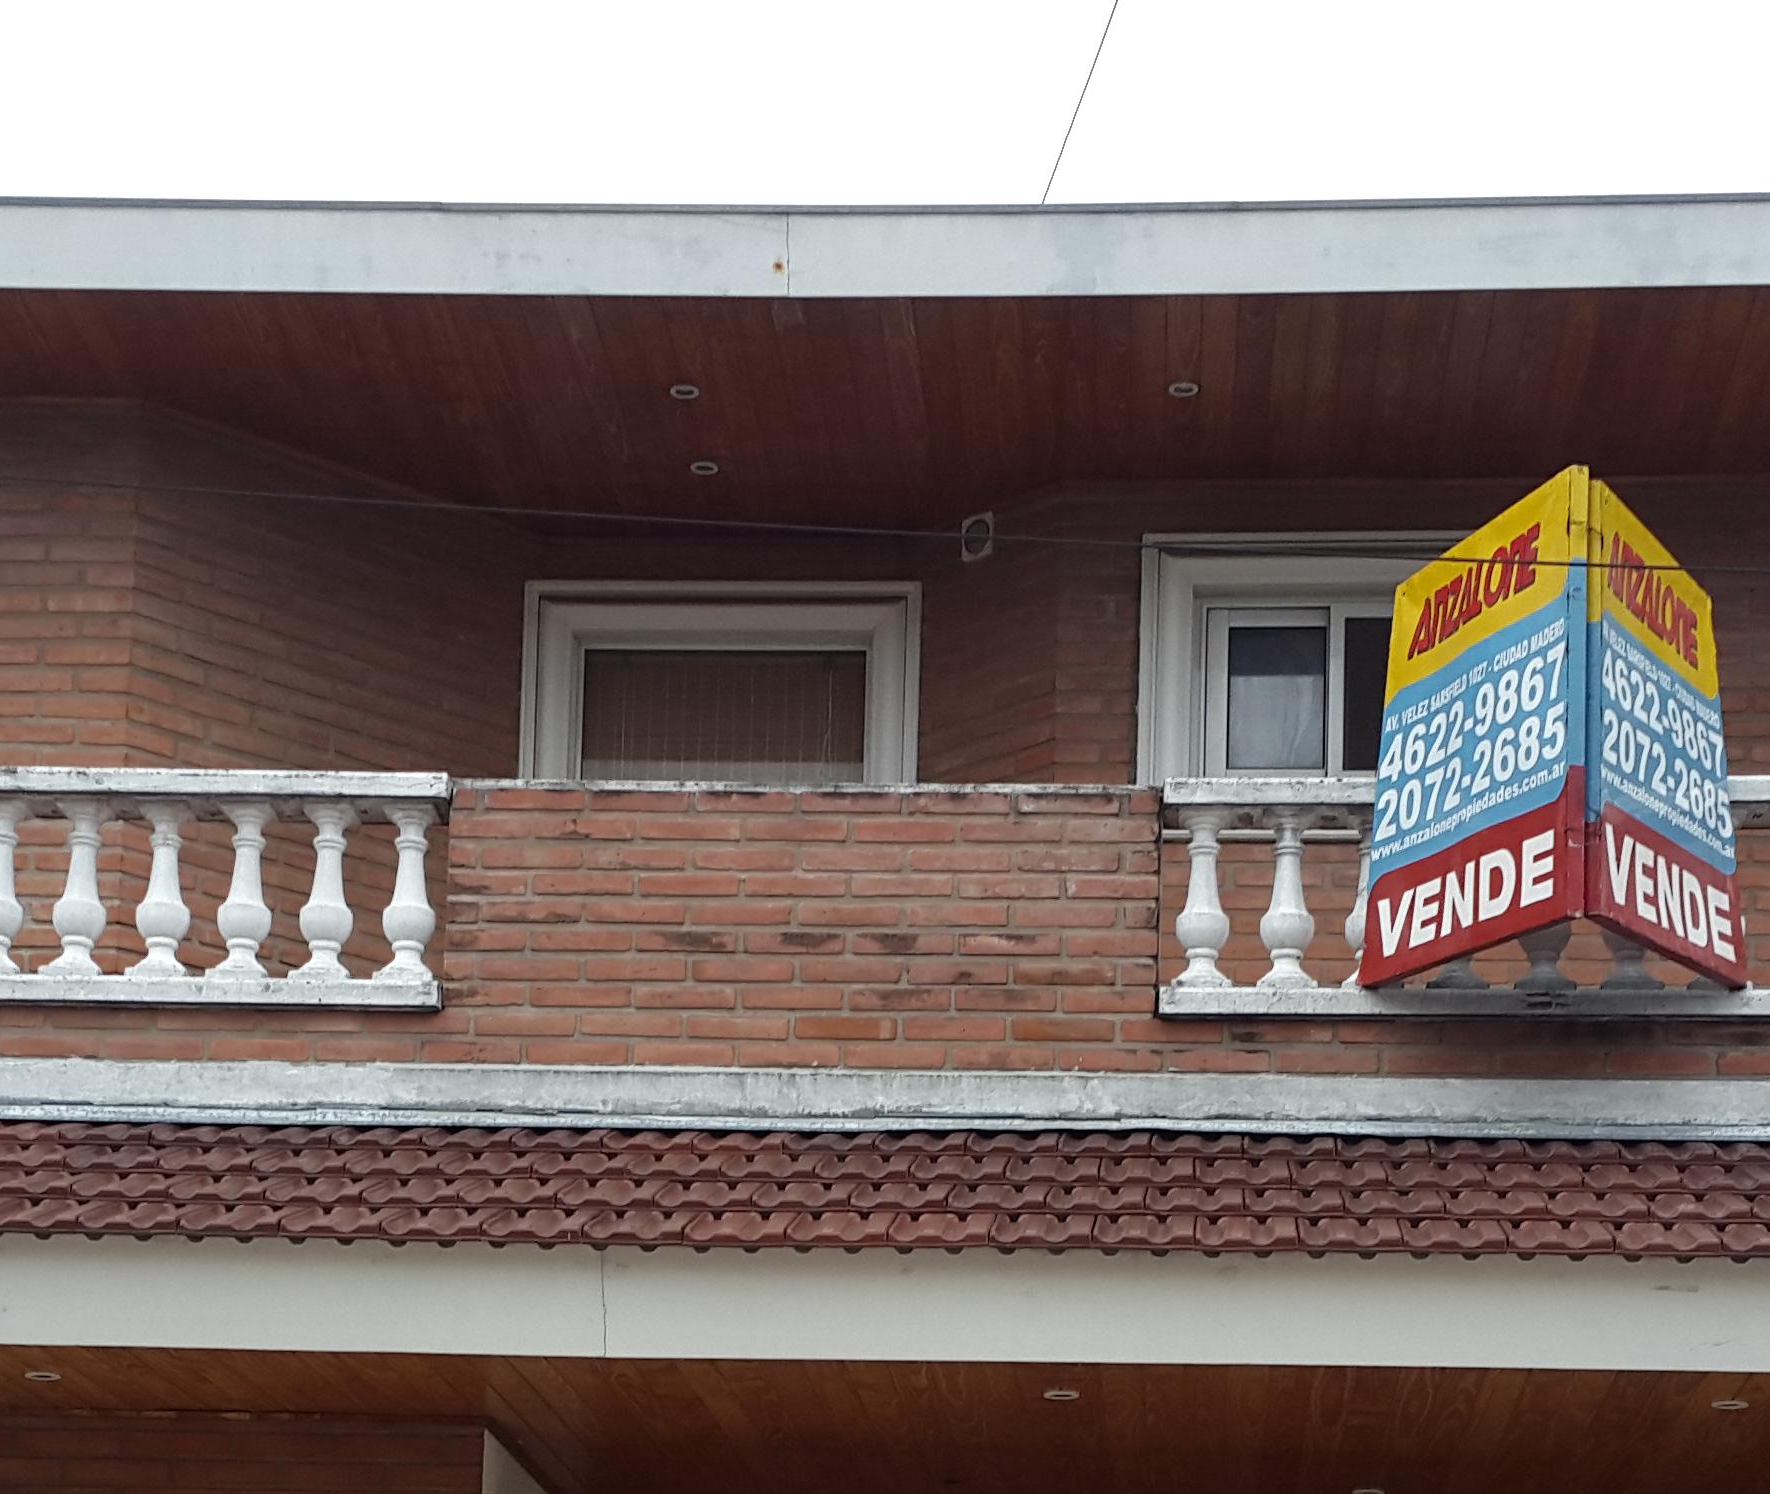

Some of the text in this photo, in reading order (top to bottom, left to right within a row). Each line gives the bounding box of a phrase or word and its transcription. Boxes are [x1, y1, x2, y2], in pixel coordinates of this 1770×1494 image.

[1408, 522, 1541, 660] ANZALONE
[1608, 531, 1699, 670] ANZALONE
[1379, 640, 1567, 783] 4622-9867
[1385, 715, 1399, 734] AV.
[1401, 702, 1429, 725] VELEZ
[1493, 640, 1528, 671] CIUDAD
[1529, 617, 1565, 655] MADERO
[1602, 647, 1723, 779] 4622-9867
[1370, 761, 1566, 862] www.anzalonepropiedades.com.ar
[1375, 700, 1566, 842] 2072-2685
[1602, 708, 1733, 838] 2072-2685
[1377, 829, 1555, 958] VENDE
[1605, 822, 1737, 963] VENDE
